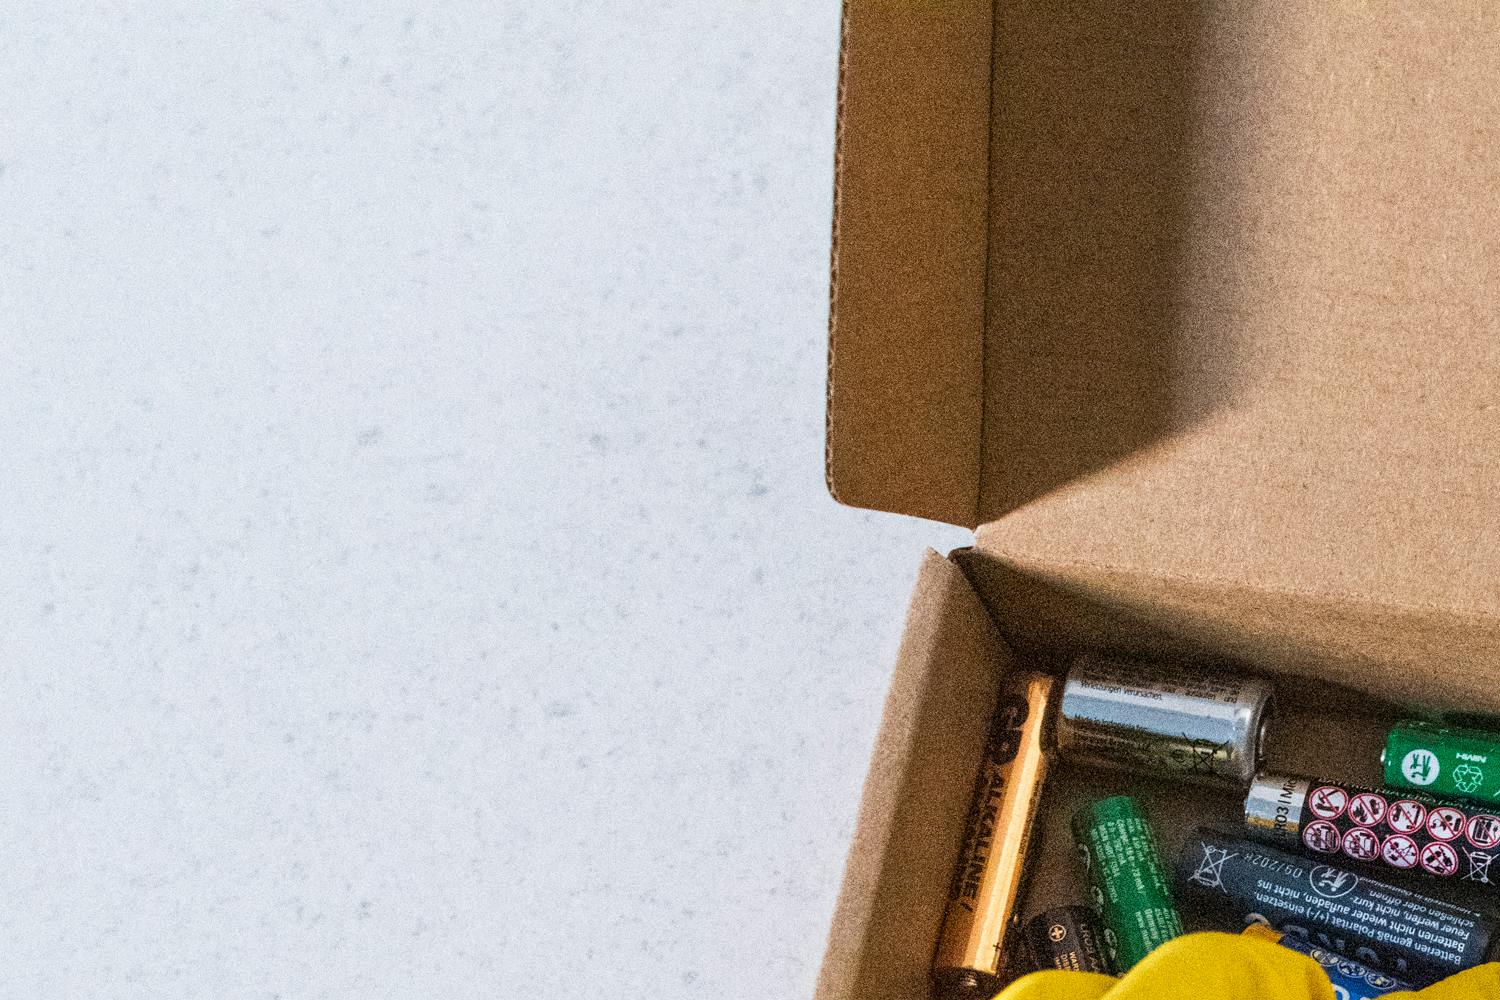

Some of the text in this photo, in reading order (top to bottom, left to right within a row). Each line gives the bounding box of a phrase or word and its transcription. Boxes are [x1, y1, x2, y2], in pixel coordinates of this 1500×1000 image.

[962, 770, 1006, 899] ALKALINE
[1254, 878, 1272, 893] ins
[1270, 882, 1301, 901] nicht
[1249, 890, 1306, 916] einsetzen.
[1300, 890, 1352, 917] aufladen,
[1373, 901, 1401, 920] nicht
[1400, 899, 1427, 914] oder
[1303, 905, 1331, 925] (+/-)
[1329, 913, 1377, 939] Polarität
[1350, 907, 1388, 929] wieder
[1400, 909, 1442, 931] werfen,
[1374, 927, 1414, 950] gemäß
[1387, 920, 1416, 938] nicht
[1440, 921, 1471, 941] Feuer
[1415, 928, 1467, 953] Batterien
[1412, 941, 1463, 966] Batterien
